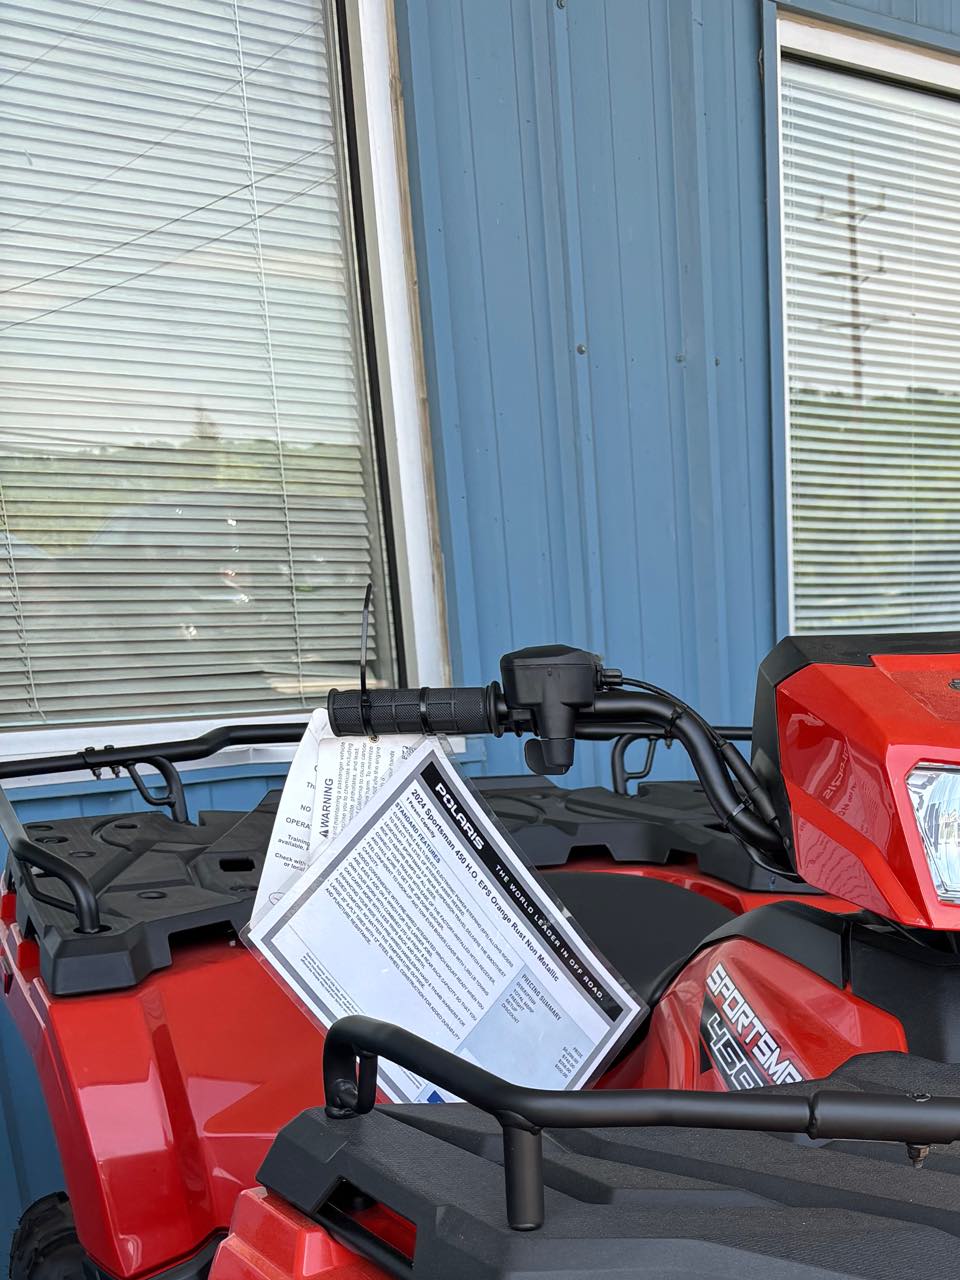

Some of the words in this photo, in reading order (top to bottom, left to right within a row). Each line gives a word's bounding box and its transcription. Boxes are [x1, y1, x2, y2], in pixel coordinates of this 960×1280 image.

[345, 743, 353, 766] including
[300, 804, 311, 812] NO
[322, 778, 334, 828] WARNING
[333, 796, 341, 825] maintaining
[407, 800, 421, 818] Person
[419, 817, 436, 839] Capacity
[434, 782, 485, 850] POLARIS
[285, 817, 312, 829] OPERA
[394, 801, 419, 834] STANDARD
[417, 832, 441, 863] FEATURES
[275, 852, 292, 863] Check
[288, 834, 311, 847] Training
[410, 788, 427, 809] 2024
[423, 807, 456, 851] Sportsman
[454, 848, 467, 864] 450
[464, 862, 479, 881] H.O.
[477, 879, 492, 897] EPS
[489, 895, 512, 924] Orange
[510, 921, 526, 941] Rust
[524, 938, 538, 956] Non
[536, 953, 560, 982] Metallic
[494, 864, 509, 883] THE
[508, 883, 534, 914] WORLD
[533, 913, 560, 947] LEADER
[559, 946, 569, 958] IN
[568, 958, 583, 975] OFF
[582, 974, 604, 1001] ROAD.
[512, 988, 524, 1002] TOTAL
[521, 973, 540, 996] PRICING
[538, 994, 561, 1021] SUMMARY
